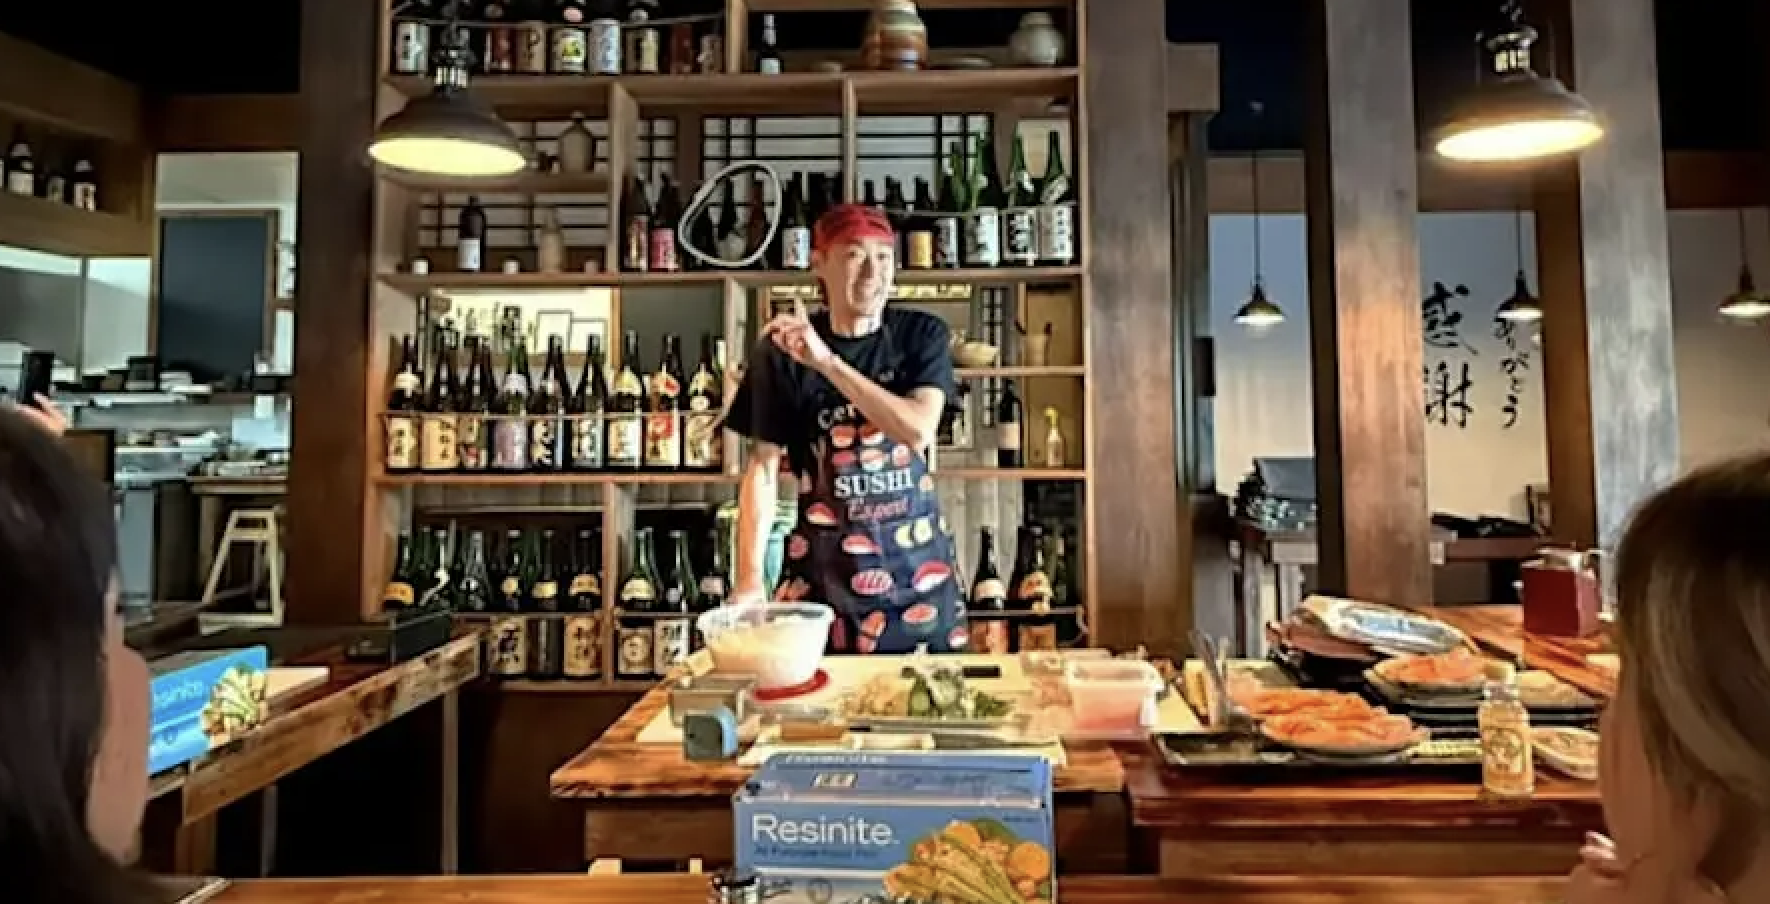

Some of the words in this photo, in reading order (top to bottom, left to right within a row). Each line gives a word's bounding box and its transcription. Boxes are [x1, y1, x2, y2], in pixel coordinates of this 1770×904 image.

[818, 404, 856, 430] Cer
[834, 468, 914, 497] SUSHI
[752, 812, 892, 845] Resinite
